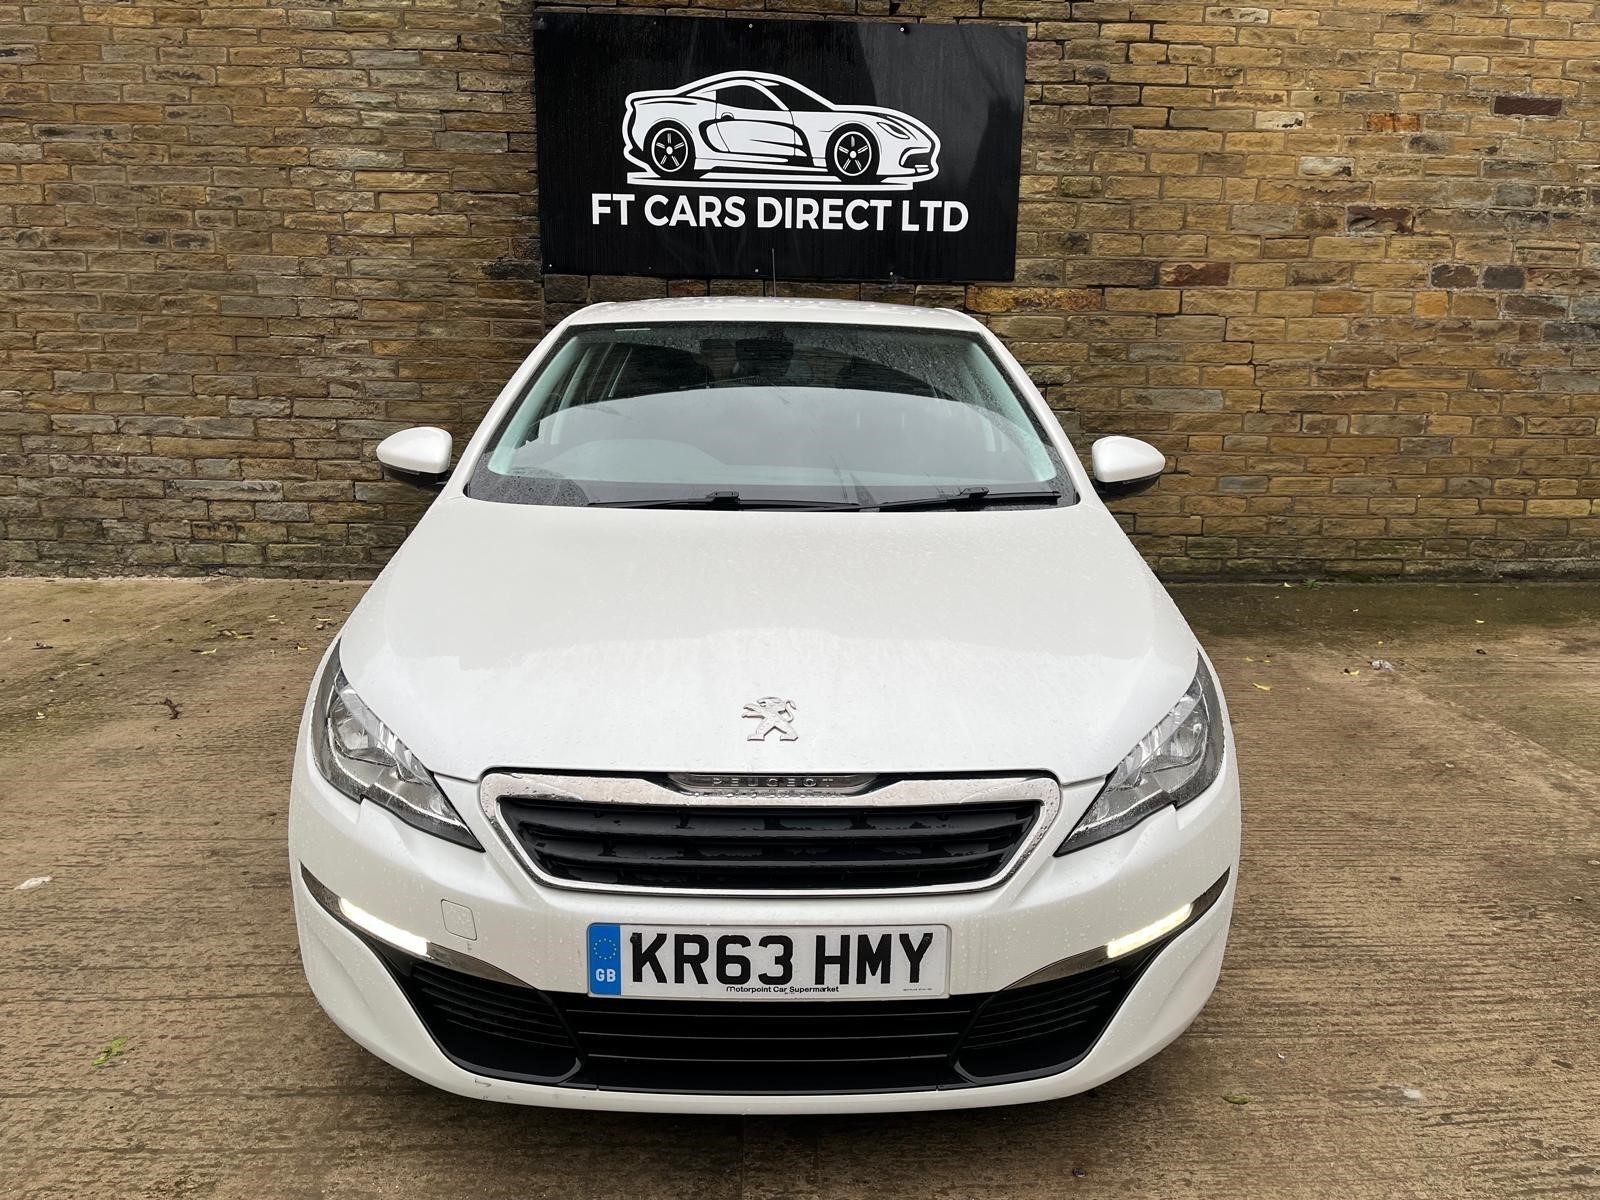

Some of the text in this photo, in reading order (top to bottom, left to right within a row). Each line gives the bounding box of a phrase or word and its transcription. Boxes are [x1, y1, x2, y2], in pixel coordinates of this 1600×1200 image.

[591, 193, 969, 233] FT CARS DIRECT LTD
[712, 777, 834, 787] PEUGEOT
[631, 932, 934, 985] KR63 HMY
[595, 968, 617, 983] GB
[726, 985, 772, 994] Motorpoint
[789, 986, 839, 994] Supermarket
